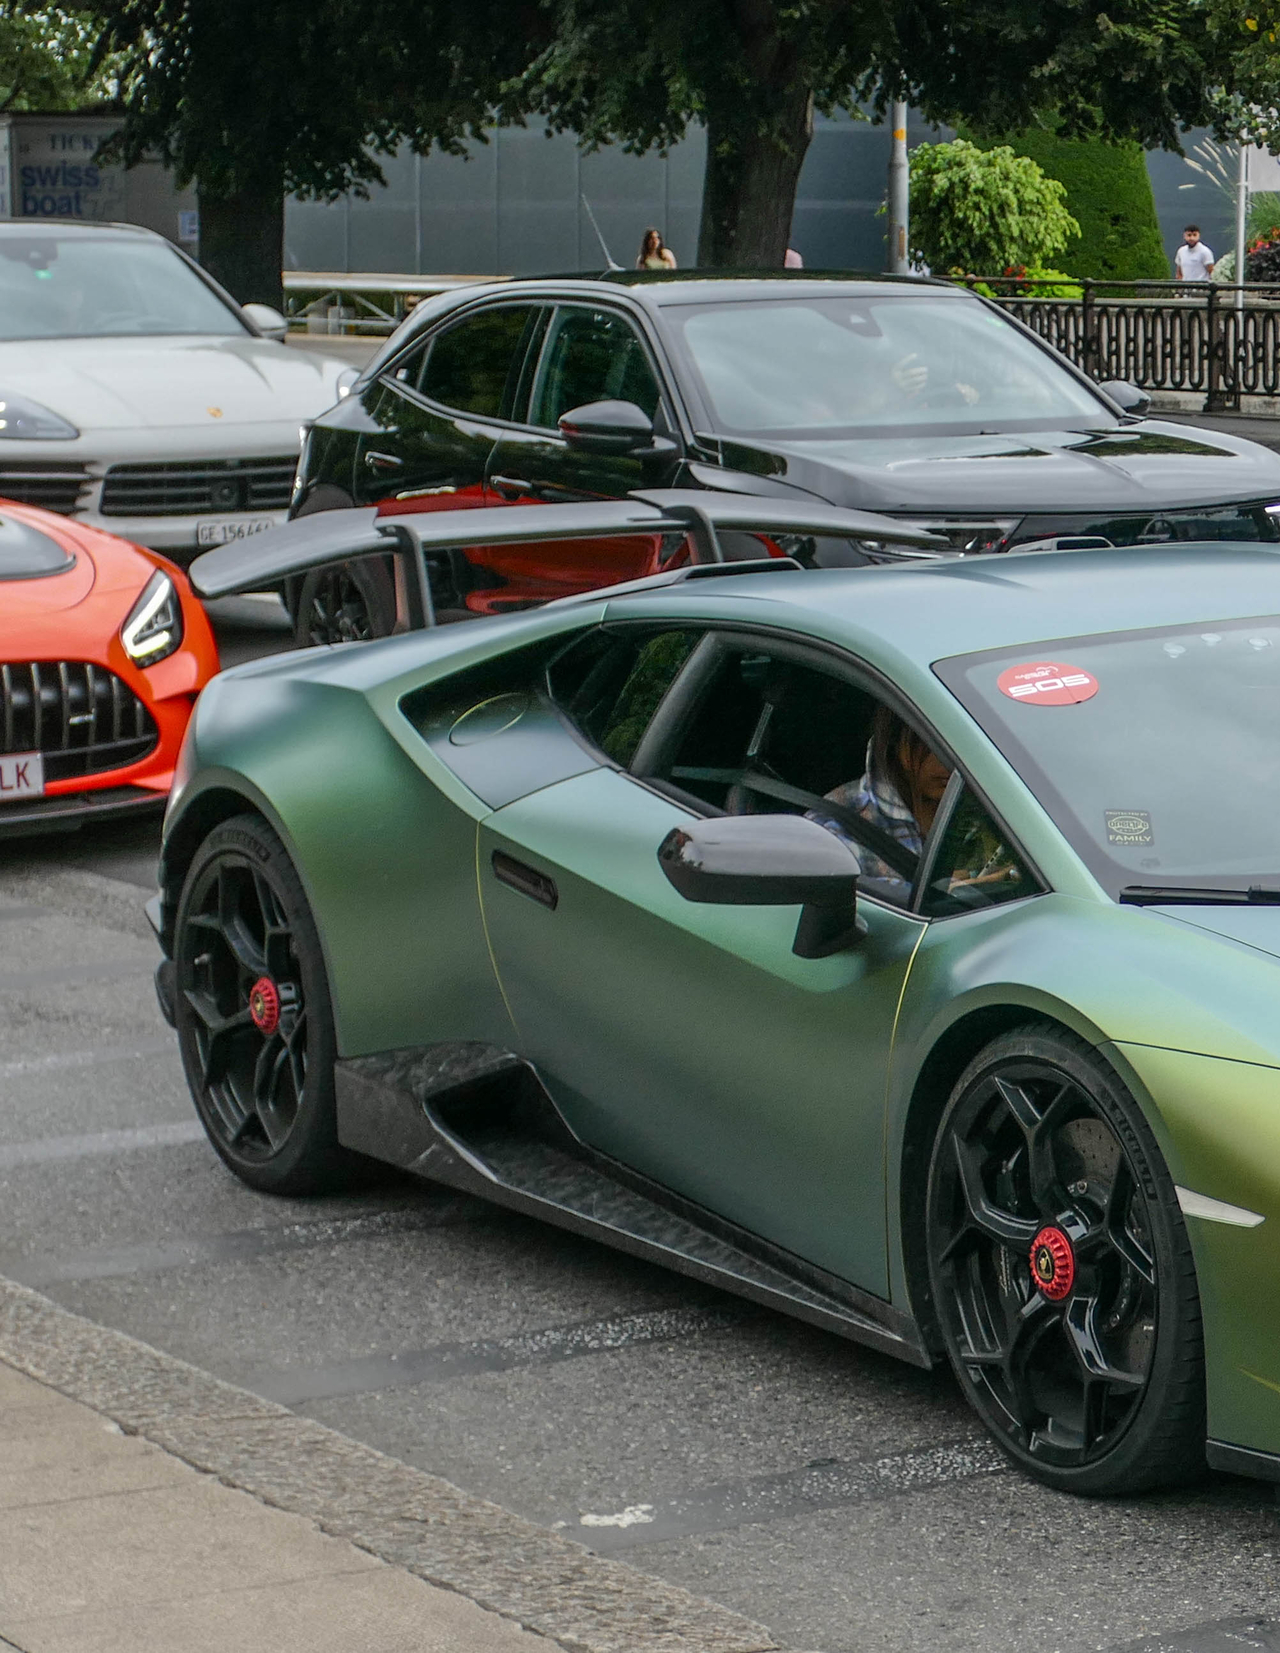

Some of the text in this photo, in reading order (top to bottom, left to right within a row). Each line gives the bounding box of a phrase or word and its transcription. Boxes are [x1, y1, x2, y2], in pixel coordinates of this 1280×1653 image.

[21, 160, 100, 187] swiss
[22, 190, 82, 215] boat
[1109, 834, 1151, 842] FAMILY
